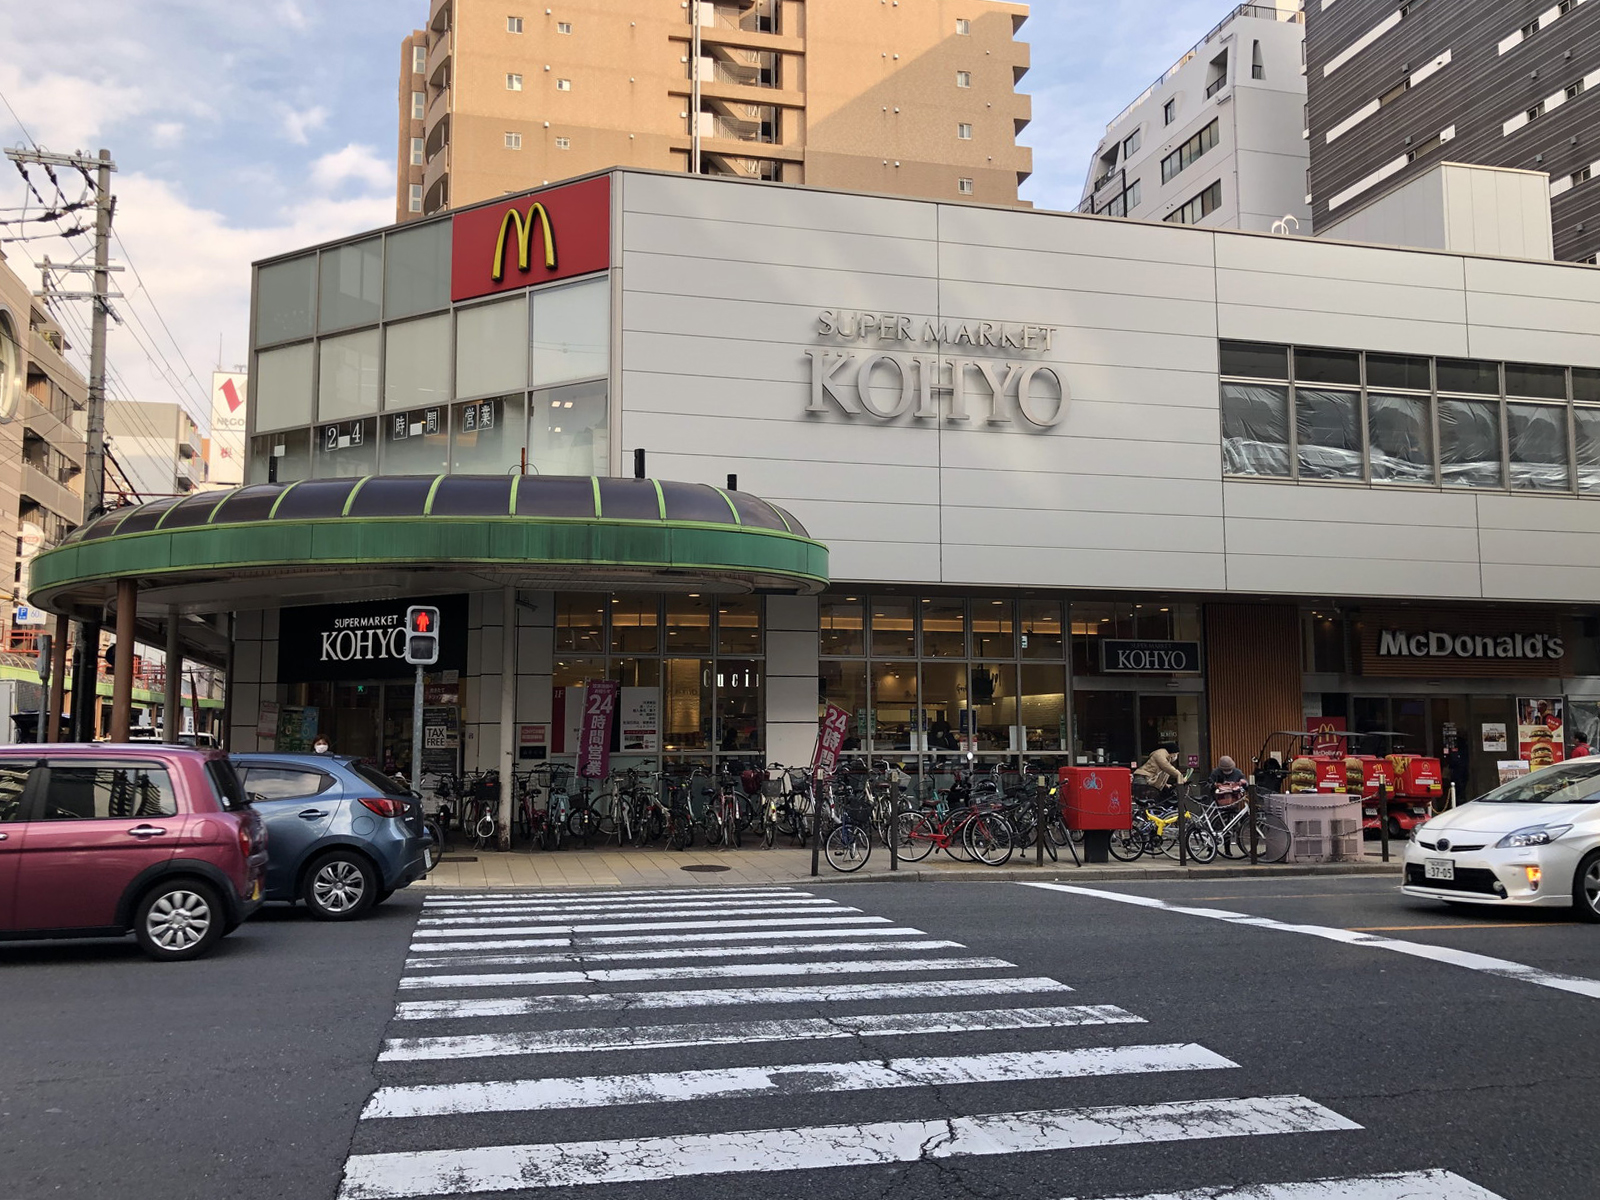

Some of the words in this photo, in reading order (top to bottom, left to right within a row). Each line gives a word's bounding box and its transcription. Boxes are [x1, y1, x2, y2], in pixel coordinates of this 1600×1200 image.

[817, 309, 915, 342] SUPER
[924, 319, 1057, 351] MARKET
[804, 349, 1072, 428] KOHYO
[334, 614, 399, 629] SUPERMARKET
[320, 626, 407, 662] KOHYO
[1379, 630, 1565, 659] McDonald's
[1117, 650, 1186, 669] KOHYO
[427, 728, 445, 737] TAX
[427, 738, 445, 746] FREE
[1431, 867, 1452, 878] 37-05
